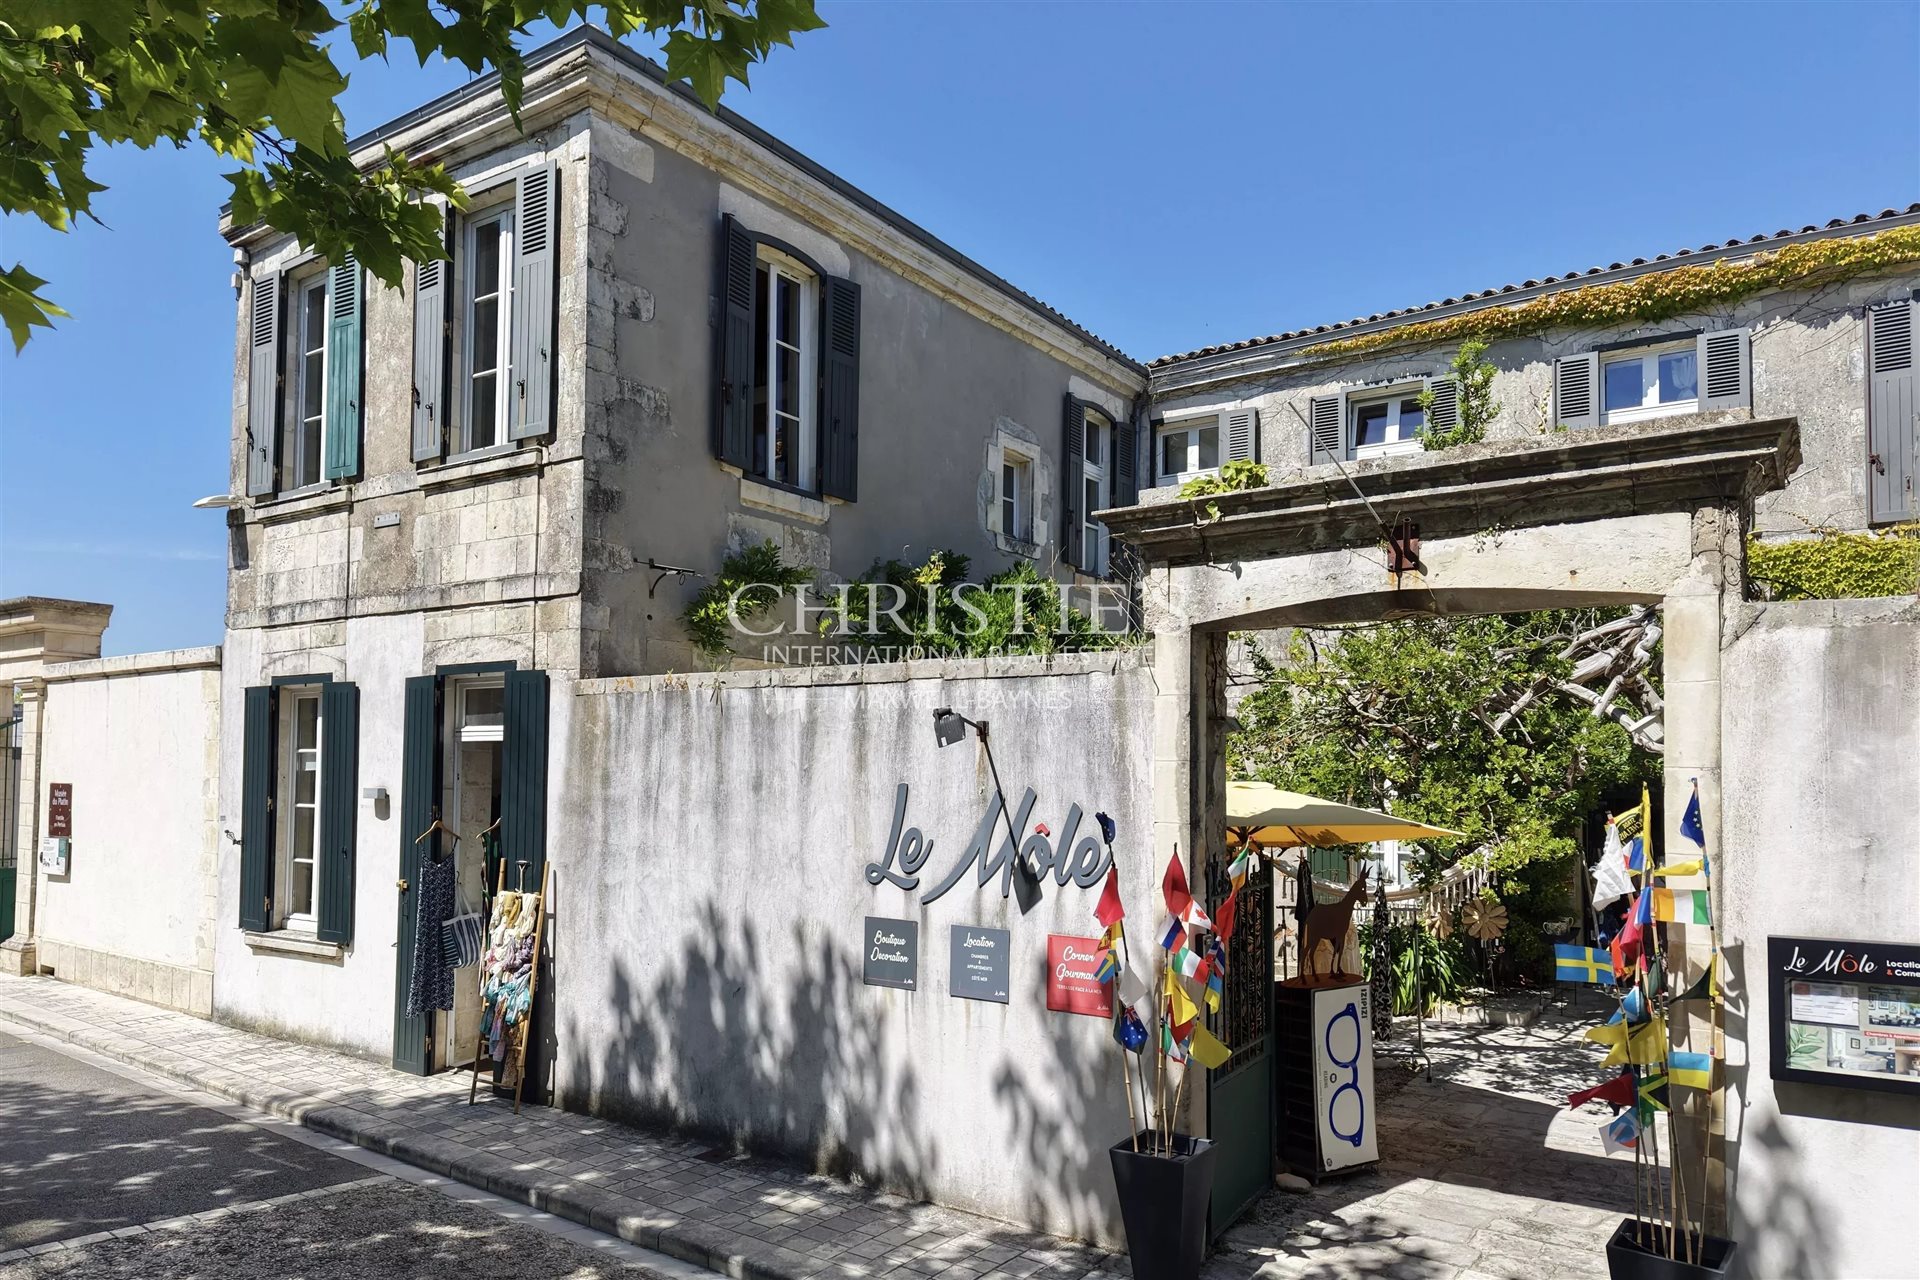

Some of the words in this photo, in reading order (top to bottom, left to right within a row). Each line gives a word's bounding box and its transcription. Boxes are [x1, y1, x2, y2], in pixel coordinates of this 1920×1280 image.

[865, 783, 934, 890] Le
[920, 786, 1112, 906] Môle
[874, 930, 906, 947] Boutique
[964, 932, 995, 948] Location
[1063, 945, 1096, 962] Corner
[1784, 946, 1808, 973] Le
[1805, 949, 1878, 976] Môle
[1056, 963, 1095, 981] Gourman
[1886, 960, 1920, 969] Locatio
[1886, 968, 1893, 976] &
[1894, 969, 1920, 978] Corne
[1360, 988, 1368, 1019] IZIPIZI
